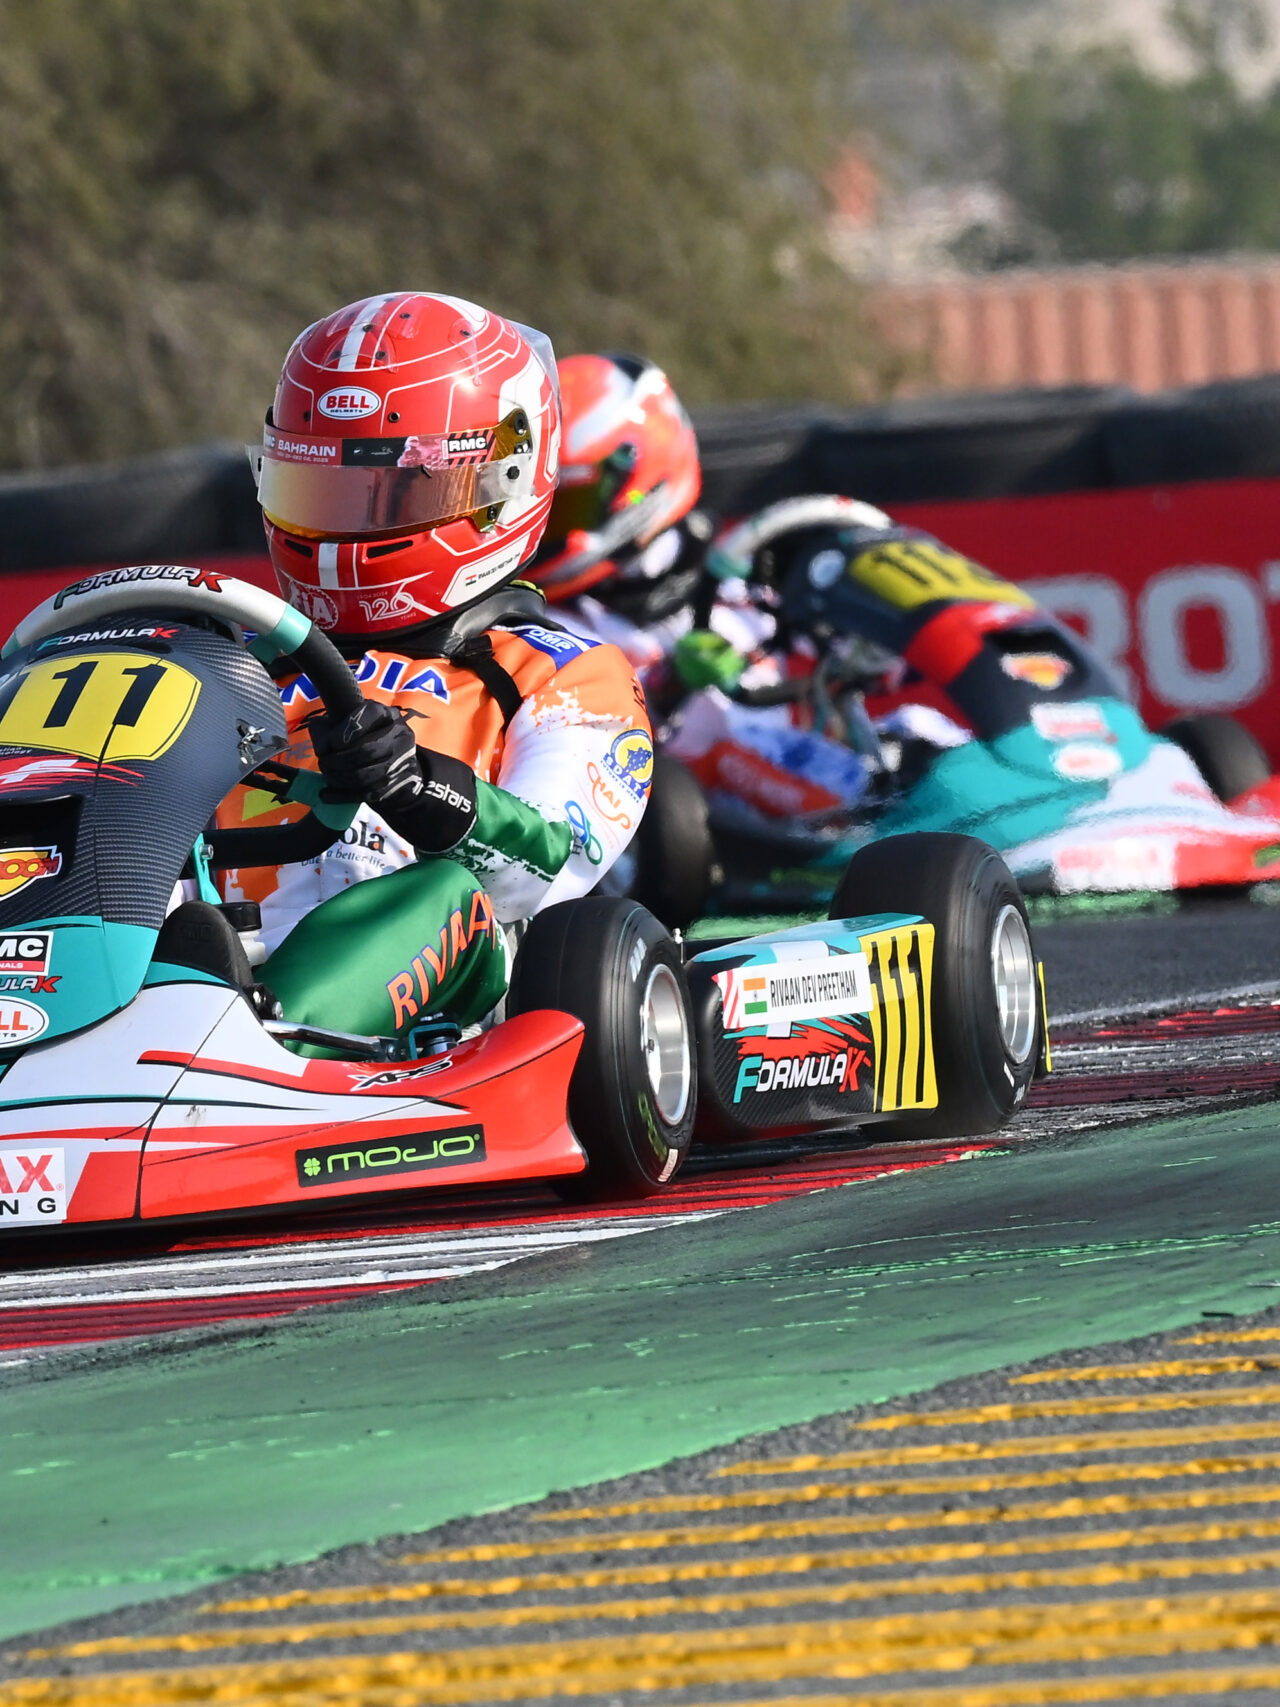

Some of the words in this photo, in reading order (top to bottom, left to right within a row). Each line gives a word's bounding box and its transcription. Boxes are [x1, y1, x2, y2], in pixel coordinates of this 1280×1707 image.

[326, 395, 370, 408] BELL
[278, 440, 336, 457] BAHRAIN
[449, 437, 486, 451] RMC
[529, 630, 571, 650] OMP
[770, 978, 801, 1008] RIVAAN
[802, 975, 817, 1003] DEV
[818, 970, 857, 1002] PREETHAM
